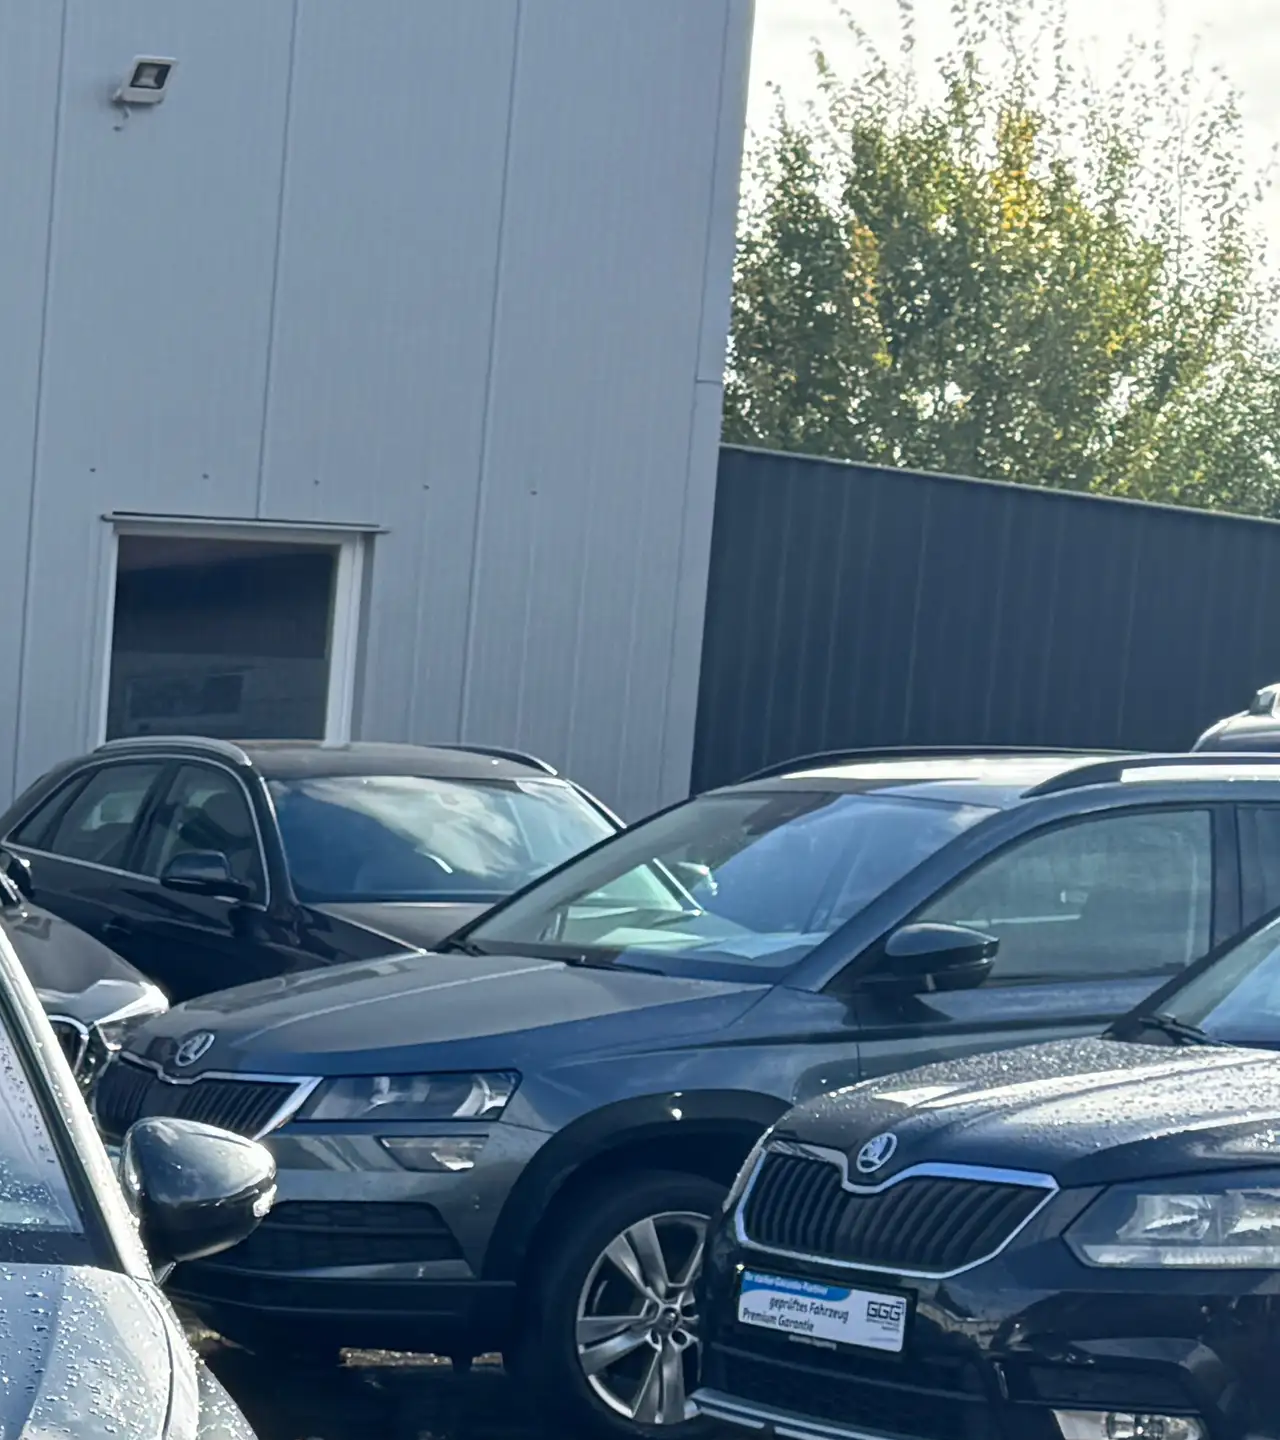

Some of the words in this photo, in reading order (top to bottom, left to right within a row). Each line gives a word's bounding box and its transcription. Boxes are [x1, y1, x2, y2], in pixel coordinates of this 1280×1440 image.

[743, 1307, 777, 1325] Premium
[778, 1314, 815, 1333] Garantie
[769, 1296, 808, 1313] geprüftes
[809, 1302, 849, 1325] Fahrzeug
[867, 1300, 902, 1322] GGG
